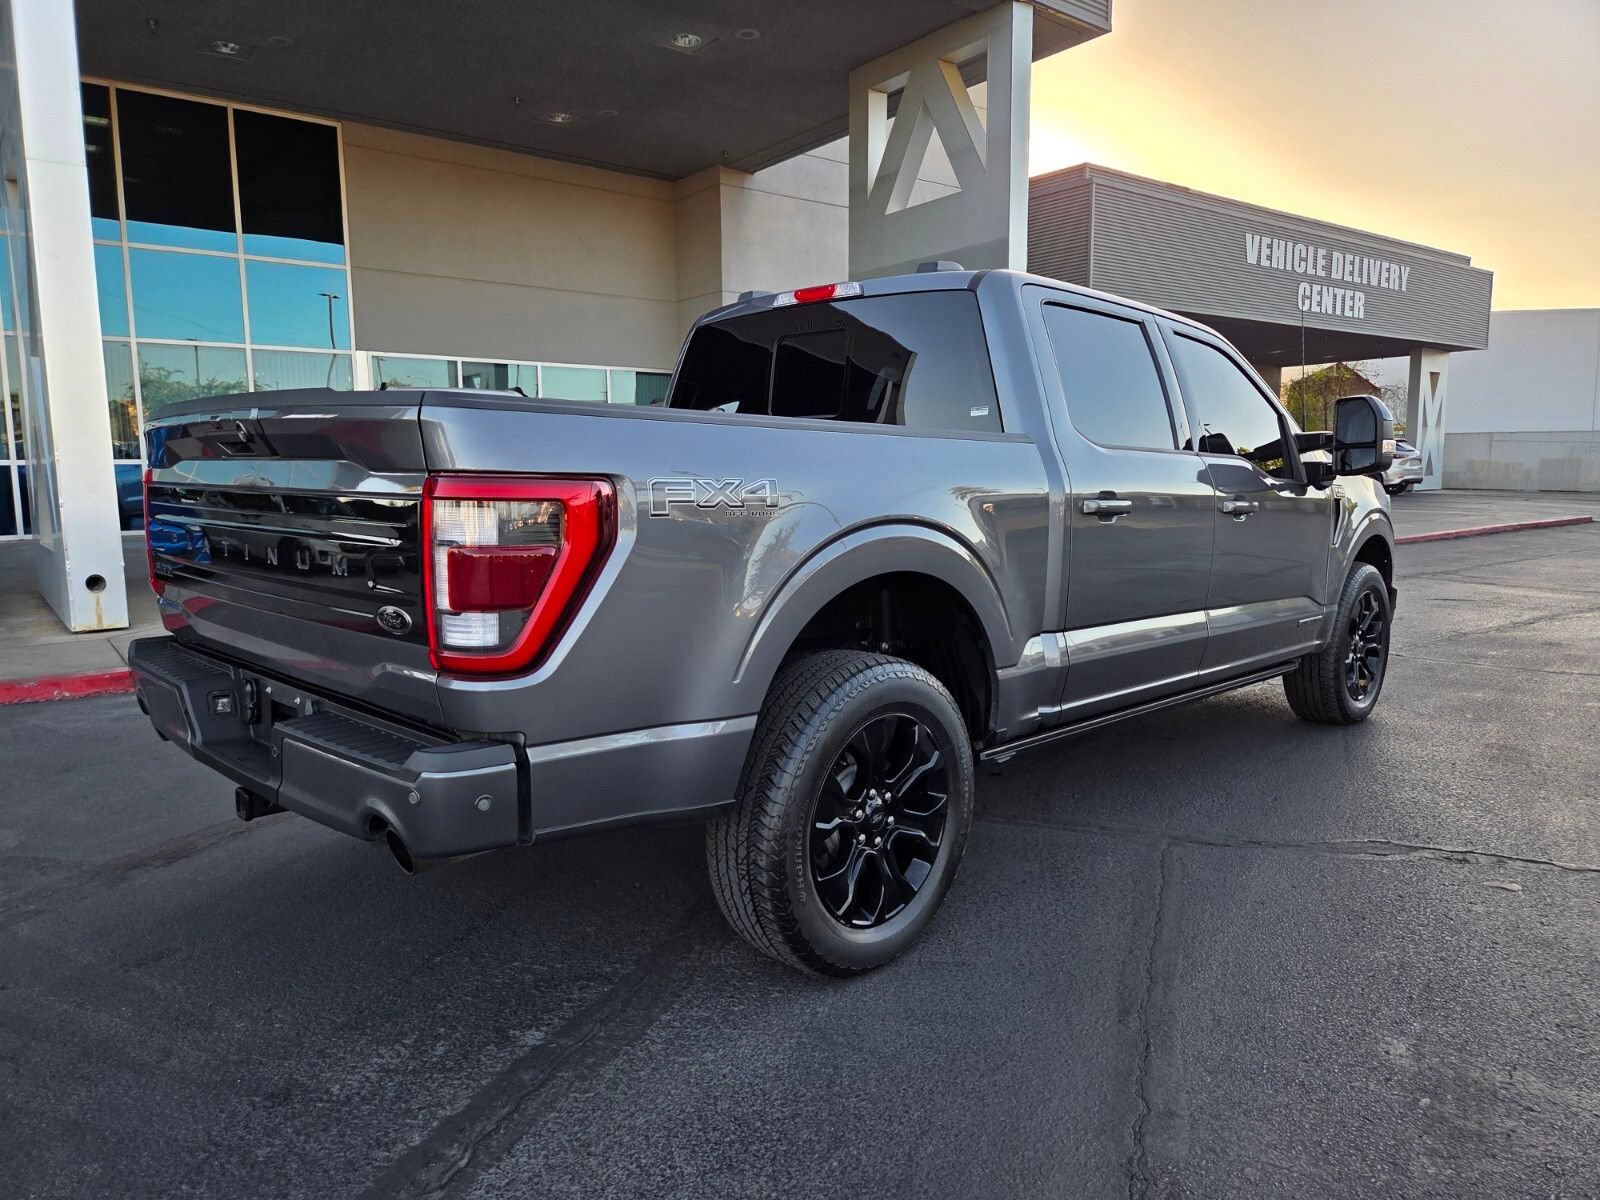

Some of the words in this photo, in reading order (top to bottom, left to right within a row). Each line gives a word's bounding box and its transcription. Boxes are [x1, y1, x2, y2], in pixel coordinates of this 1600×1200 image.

[1245, 233, 1326, 277] VEHICLE
[1331, 251, 1410, 291] DELIVERY
[1298, 282, 1365, 319] CENTER
[647, 477, 780, 518] FX4
[725, 510, 747, 518] OFF
